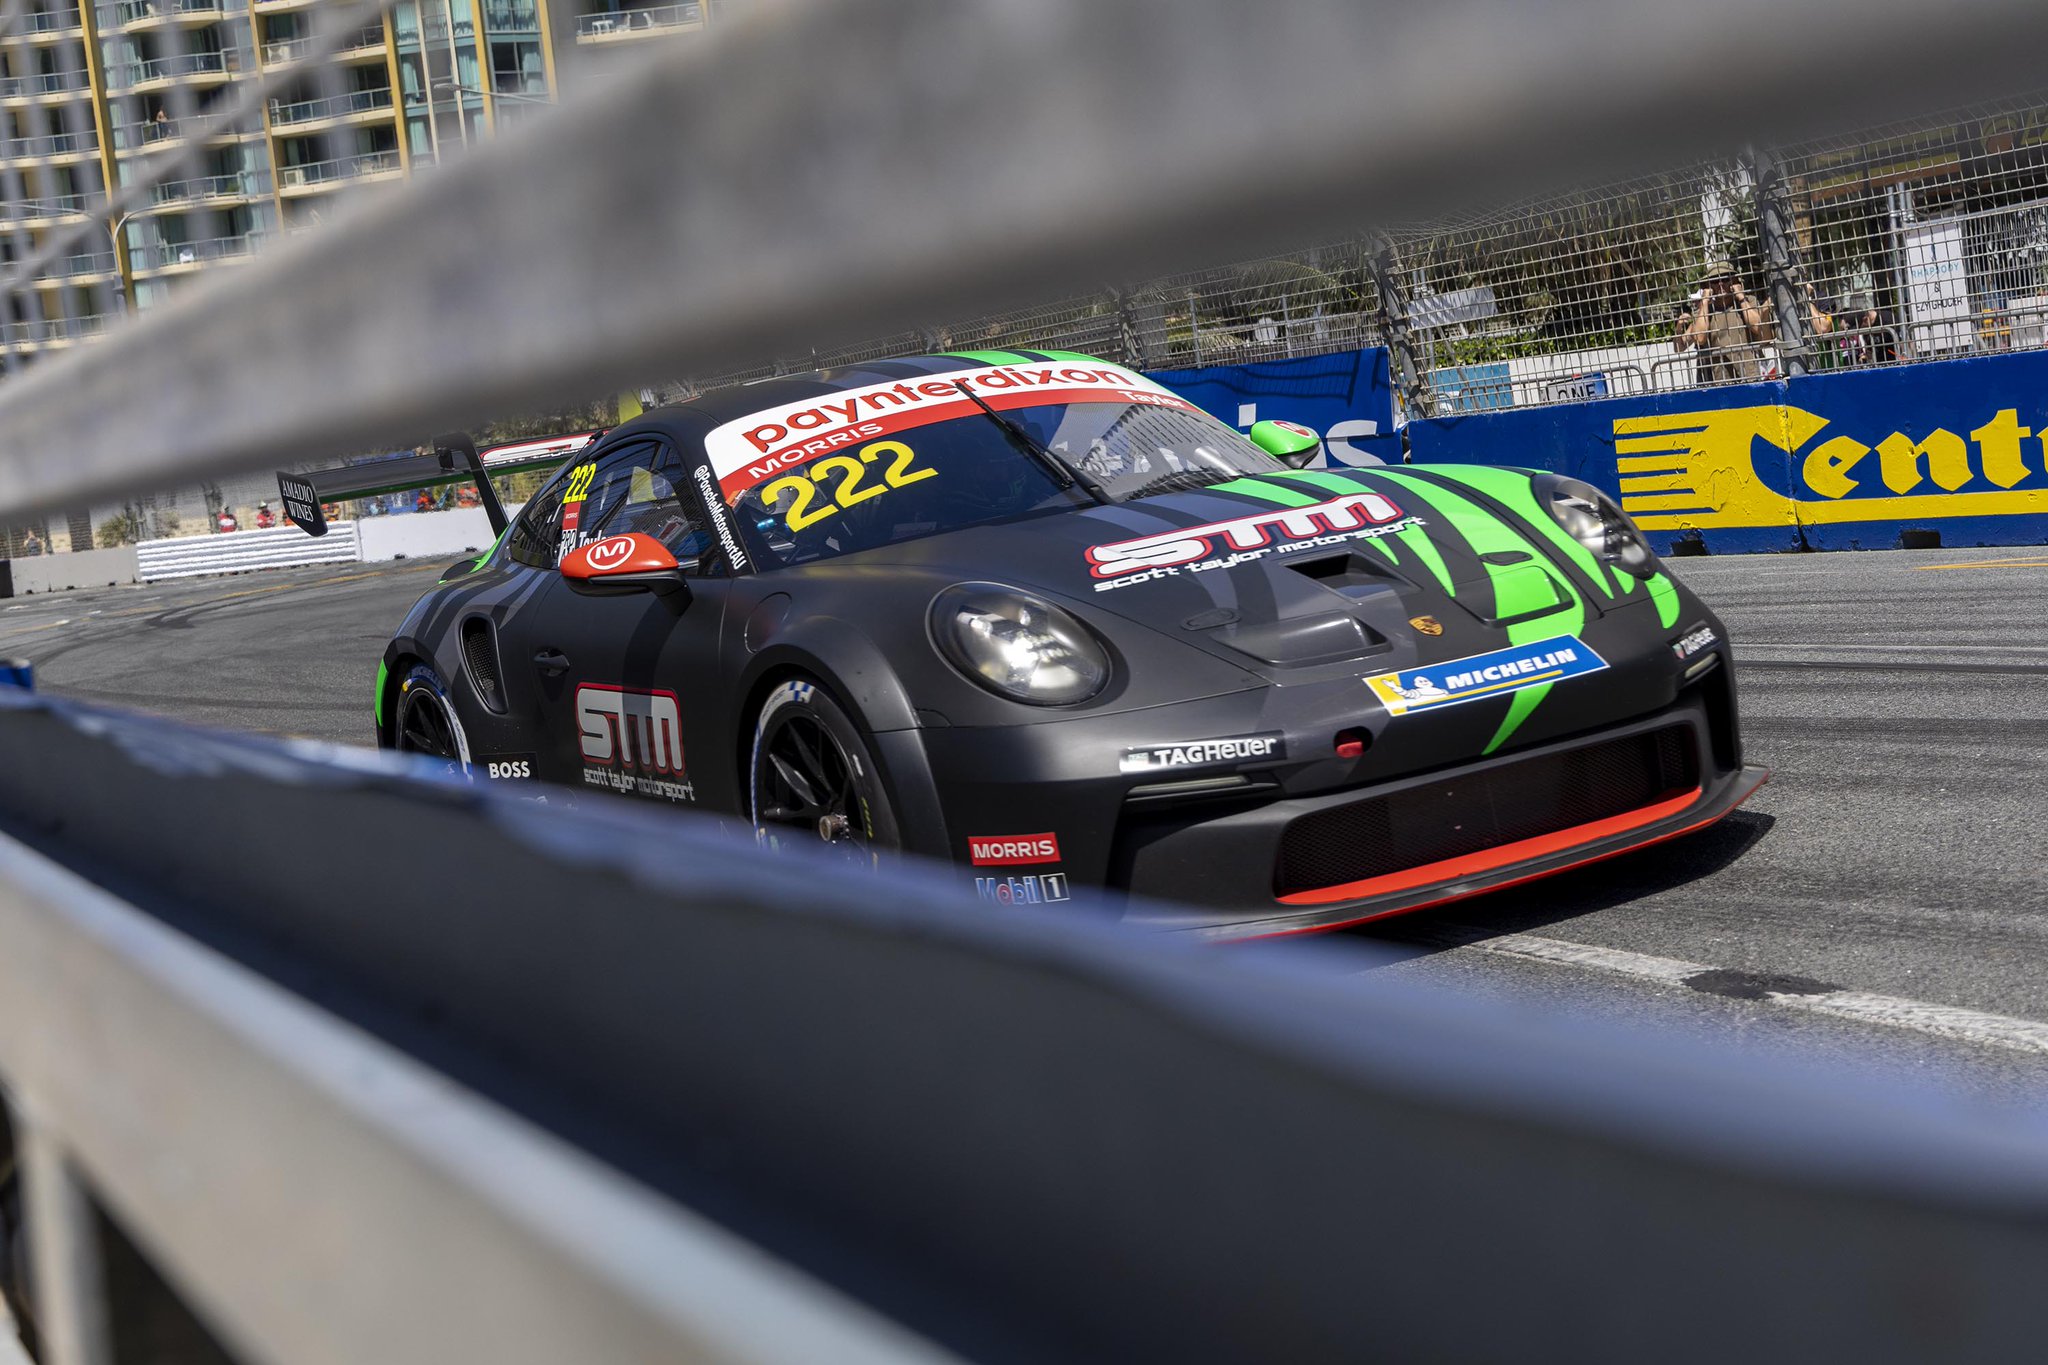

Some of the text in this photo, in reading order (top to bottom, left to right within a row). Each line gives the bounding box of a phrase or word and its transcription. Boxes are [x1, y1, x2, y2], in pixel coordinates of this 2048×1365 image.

[742, 367, 1134, 453] paynterdixon
[1117, 391, 1185, 407] Taylor
[748, 423, 883, 479] MORRIS
[1613, 404, 2048, 530] Cent
[282, 479, 314, 504] AMADIO
[562, 463, 597, 504] 222
[761, 440, 939, 533] 222
[287, 500, 314, 523] WINES
[694, 464, 747, 571] @PorscheMotorsportAU
[594, 541, 627, 560] M
[1094, 515, 1426, 592] scott taylor motorsport
[1445, 648, 1577, 690] MICHELIN
[488, 760, 531, 779] BOSS
[583, 766, 696, 802] scott taylor motorsport
[973, 839, 1056, 859] MORRIS
[975, 875, 1041, 905] Mobil
